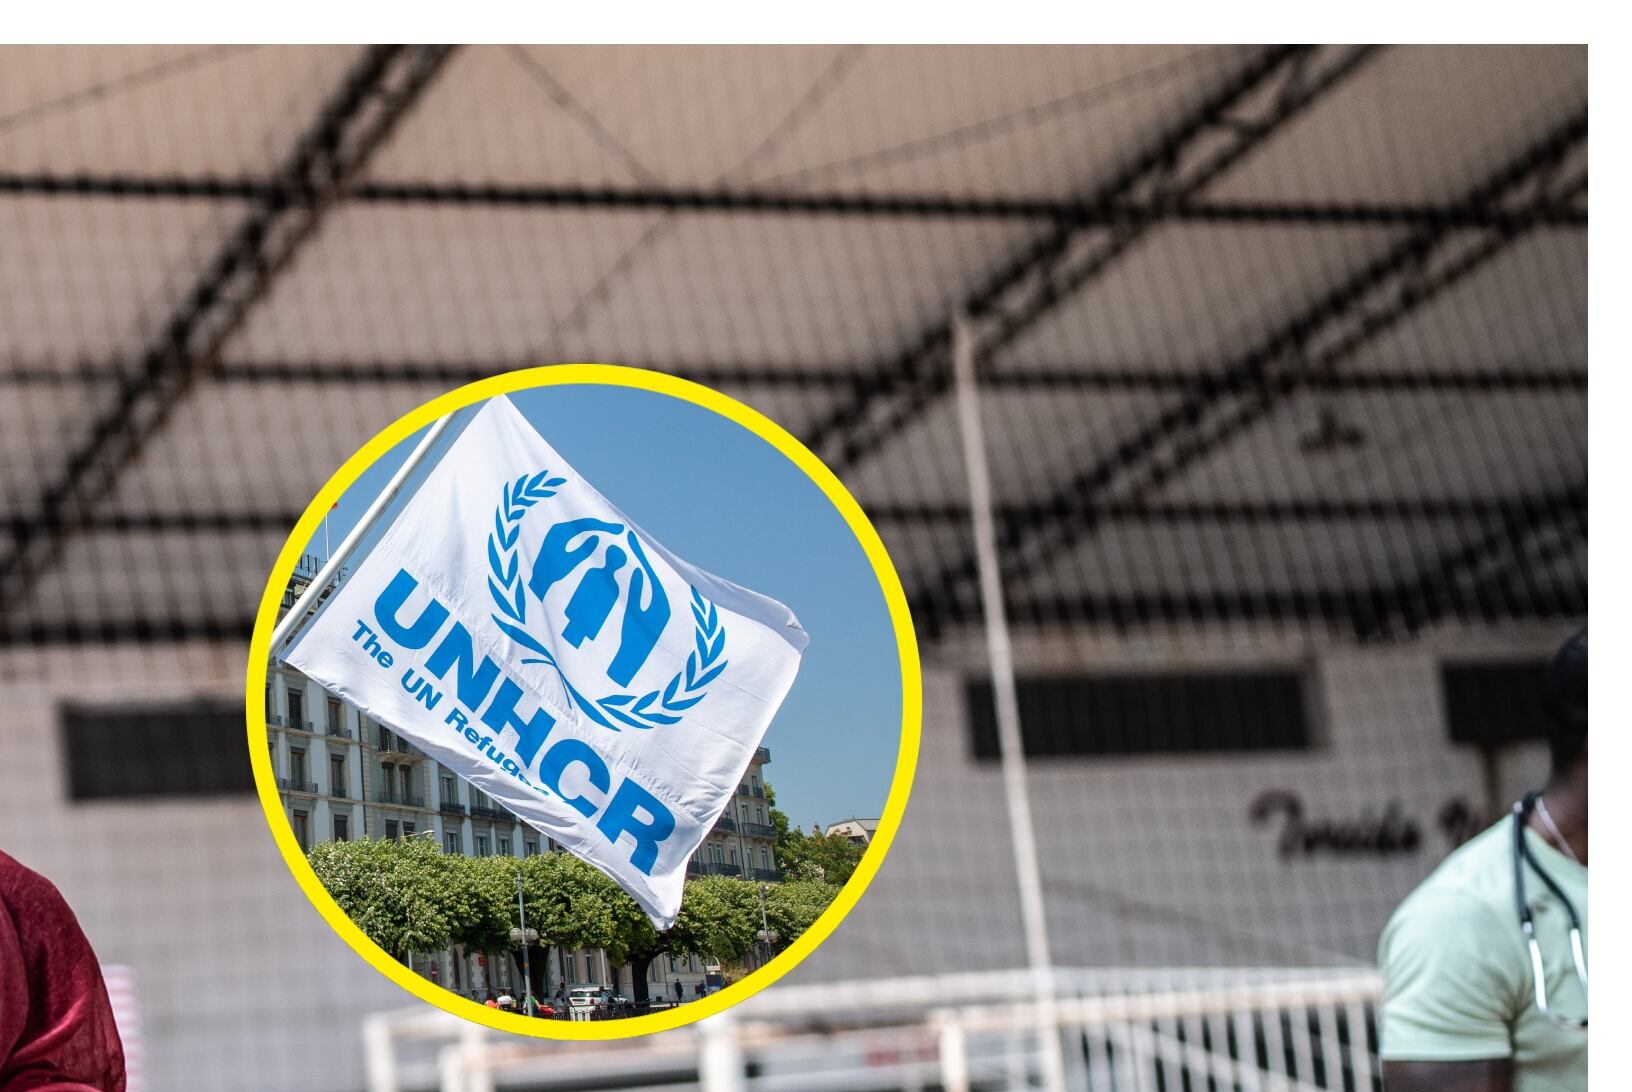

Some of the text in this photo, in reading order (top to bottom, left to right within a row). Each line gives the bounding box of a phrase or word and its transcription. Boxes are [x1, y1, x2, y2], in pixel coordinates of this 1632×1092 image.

[351, 618, 395, 669] The
[400, 667, 444, 712] UN
[373, 567, 677, 877] UNHCR
